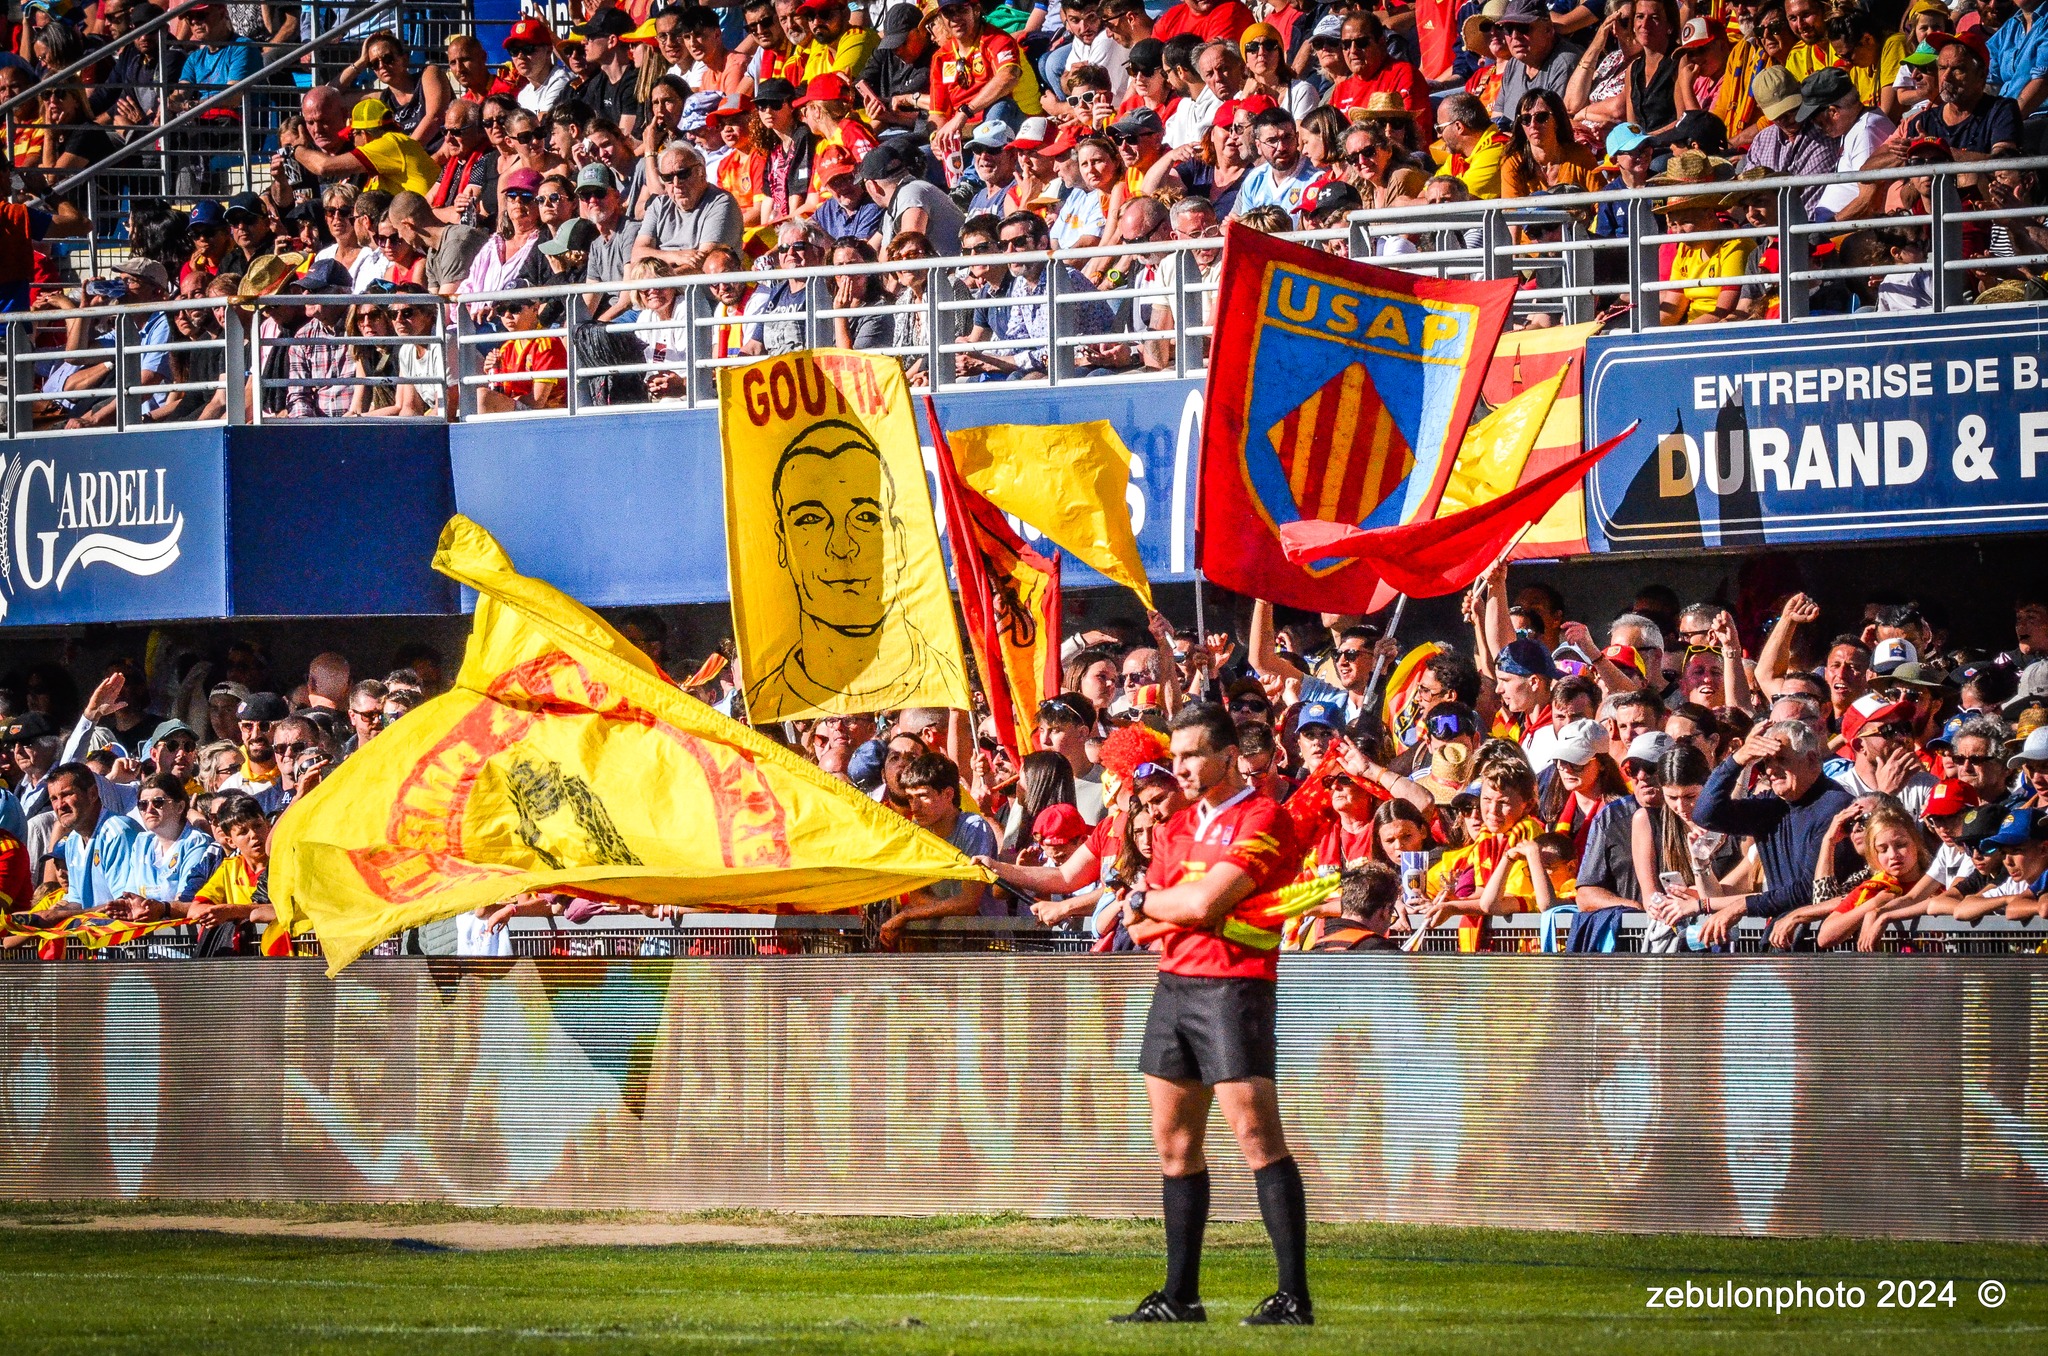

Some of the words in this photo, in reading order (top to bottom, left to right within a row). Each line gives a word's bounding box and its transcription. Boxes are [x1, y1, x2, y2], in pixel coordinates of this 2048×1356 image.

[1276, 276, 1460, 350] USAP
[742, 354, 889, 427] GOUTTA
[1693, 361, 1934, 410] ENTREPRISE
[1947, 357, 1999, 395] DE
[1657, 418, 1928, 498] DURAND
[1952, 413, 1999, 482] &
[16, 459, 174, 590] GARDELL
